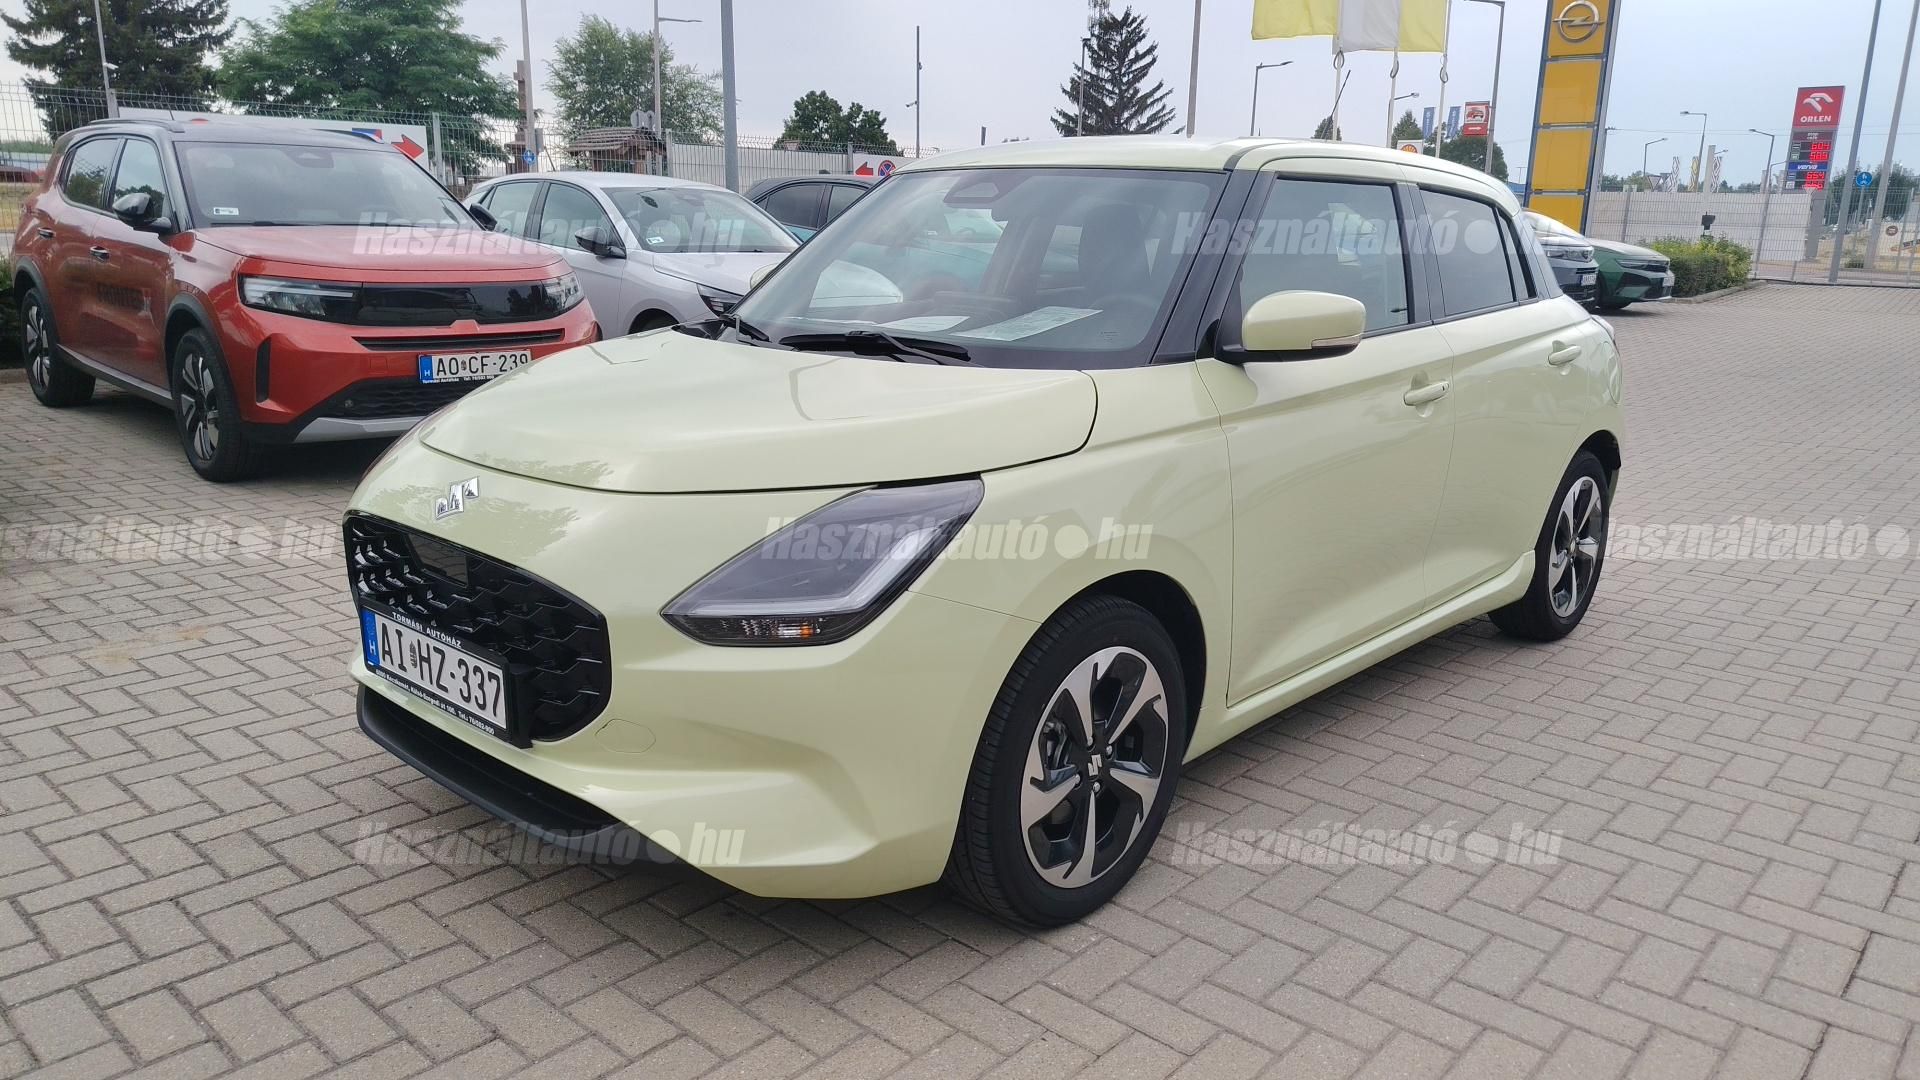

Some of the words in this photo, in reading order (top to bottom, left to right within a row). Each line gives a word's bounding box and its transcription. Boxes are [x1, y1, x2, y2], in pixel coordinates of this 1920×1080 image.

[1800, 115, 1832, 123] ORLEN
[424, 369, 431, 377] H
[436, 357, 459, 377] AO
[426, 627, 462, 648] AUTÓHÁZ
[368, 639, 377, 656] H
[381, 622, 408, 672] AI
[416, 638, 501, 718] HZ-337
